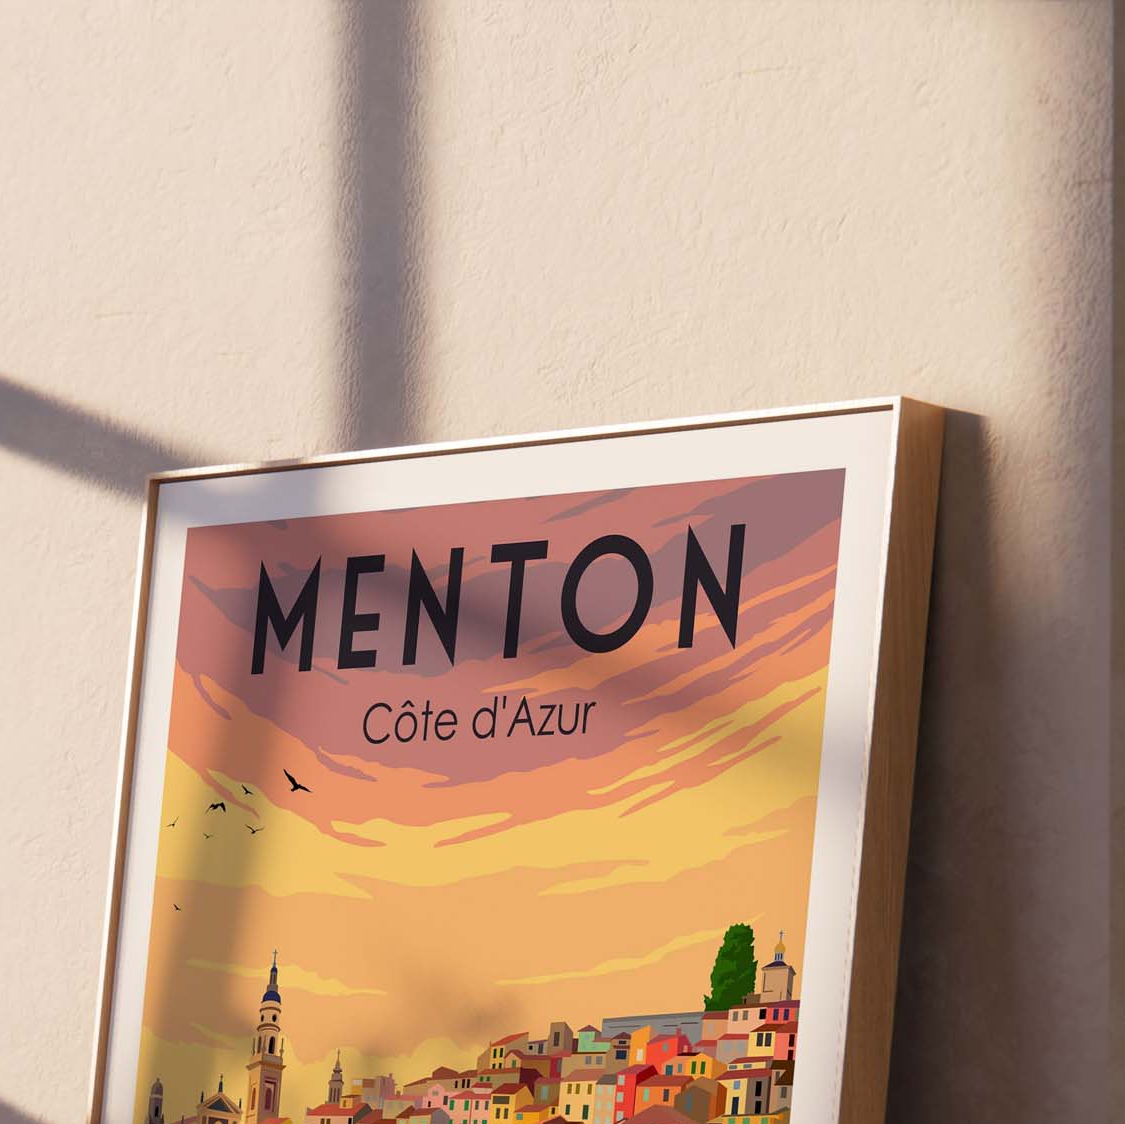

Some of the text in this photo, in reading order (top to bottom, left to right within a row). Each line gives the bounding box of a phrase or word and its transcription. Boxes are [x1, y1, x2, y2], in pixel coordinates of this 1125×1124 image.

[250, 523, 747, 675] MENTON
[362, 695, 597, 745] Côte d'Azur
